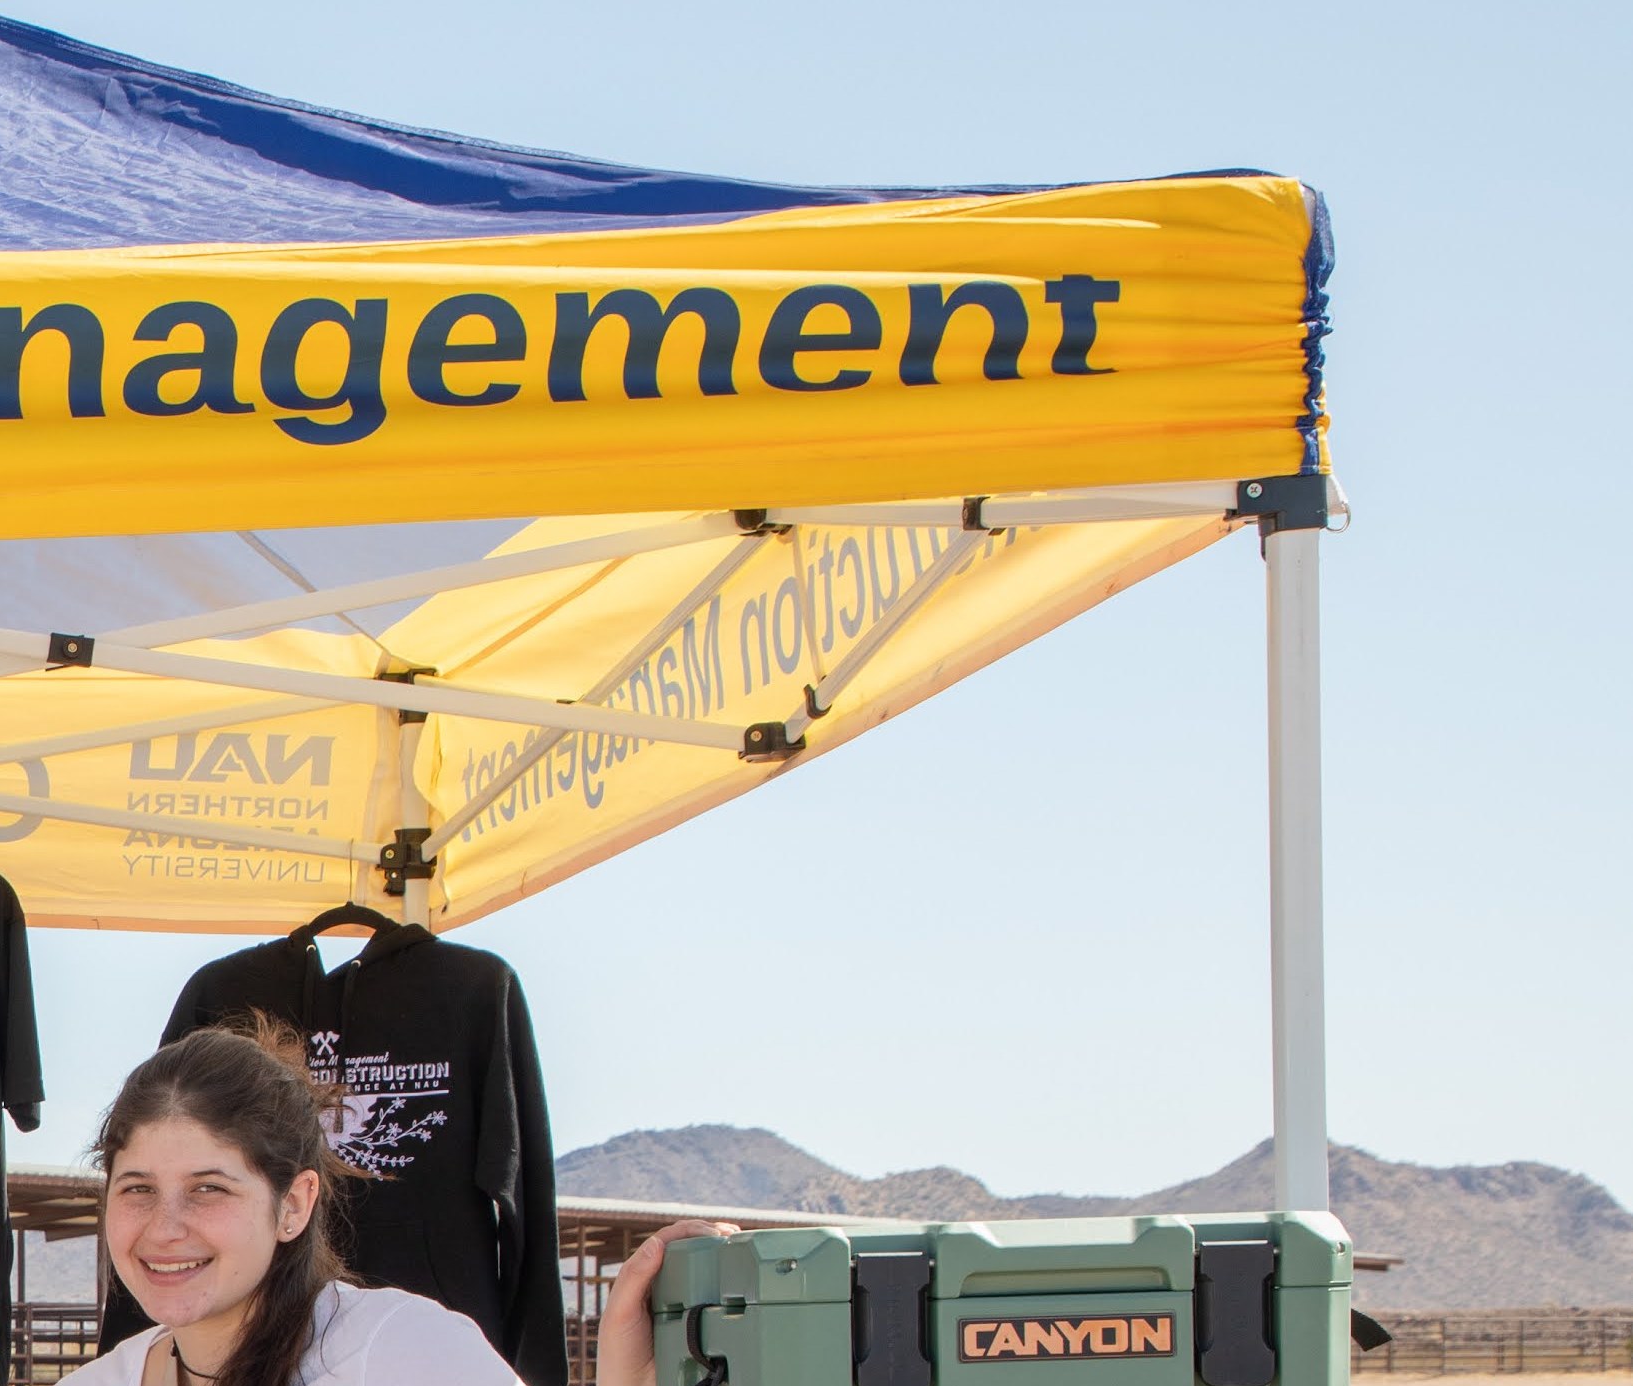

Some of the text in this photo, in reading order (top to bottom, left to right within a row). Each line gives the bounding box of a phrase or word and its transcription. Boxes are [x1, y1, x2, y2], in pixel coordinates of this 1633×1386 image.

[390, 1082, 404, 1090] AT
[415, 1080, 439, 1089] NAU
[963, 1316, 1172, 1358] CANYON
